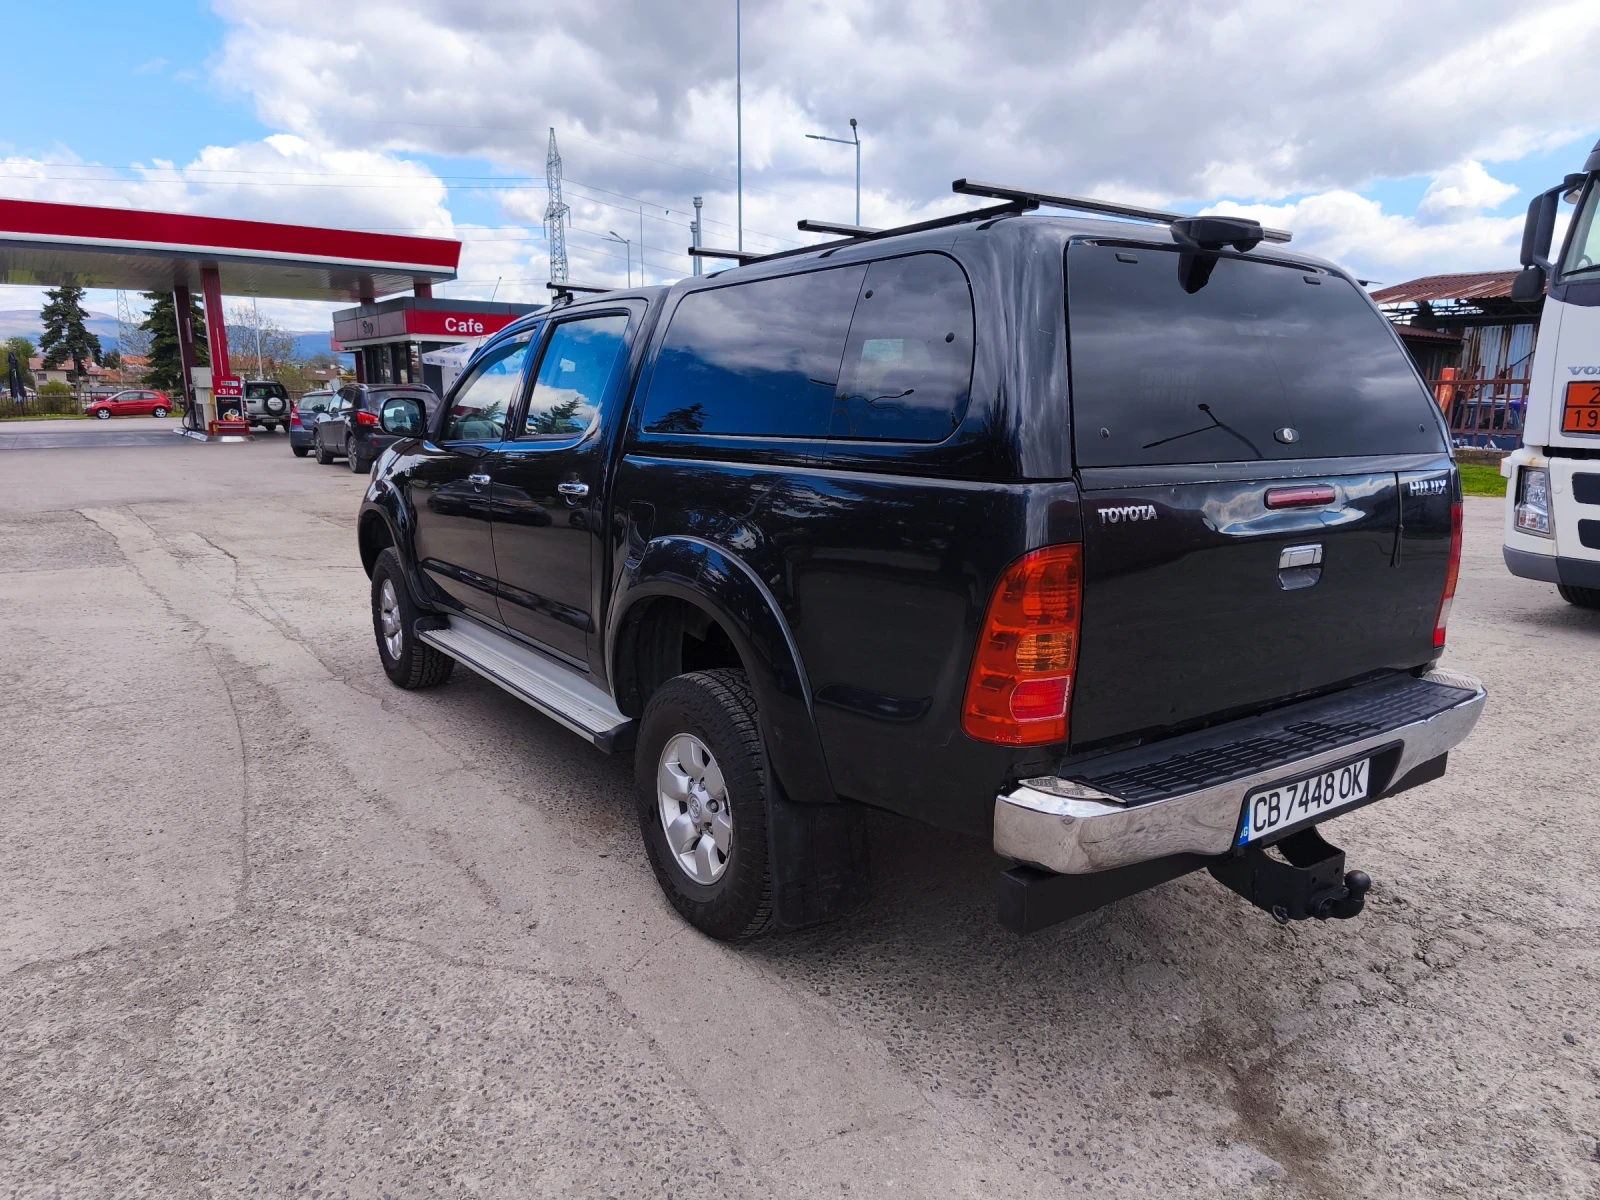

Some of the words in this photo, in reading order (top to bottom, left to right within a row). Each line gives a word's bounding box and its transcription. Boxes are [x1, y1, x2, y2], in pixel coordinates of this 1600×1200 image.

[445, 317, 484, 333] Cafe
[1567, 366, 1600, 376] VO
[1574, 409, 1599, 428] 19
[1408, 479, 1448, 497] HILUX
[1097, 504, 1158, 524] TOYOTA
[1253, 791, 1281, 833] CB
[1285, 772, 1335, 822] 7448
[1339, 761, 1365, 800] OK
